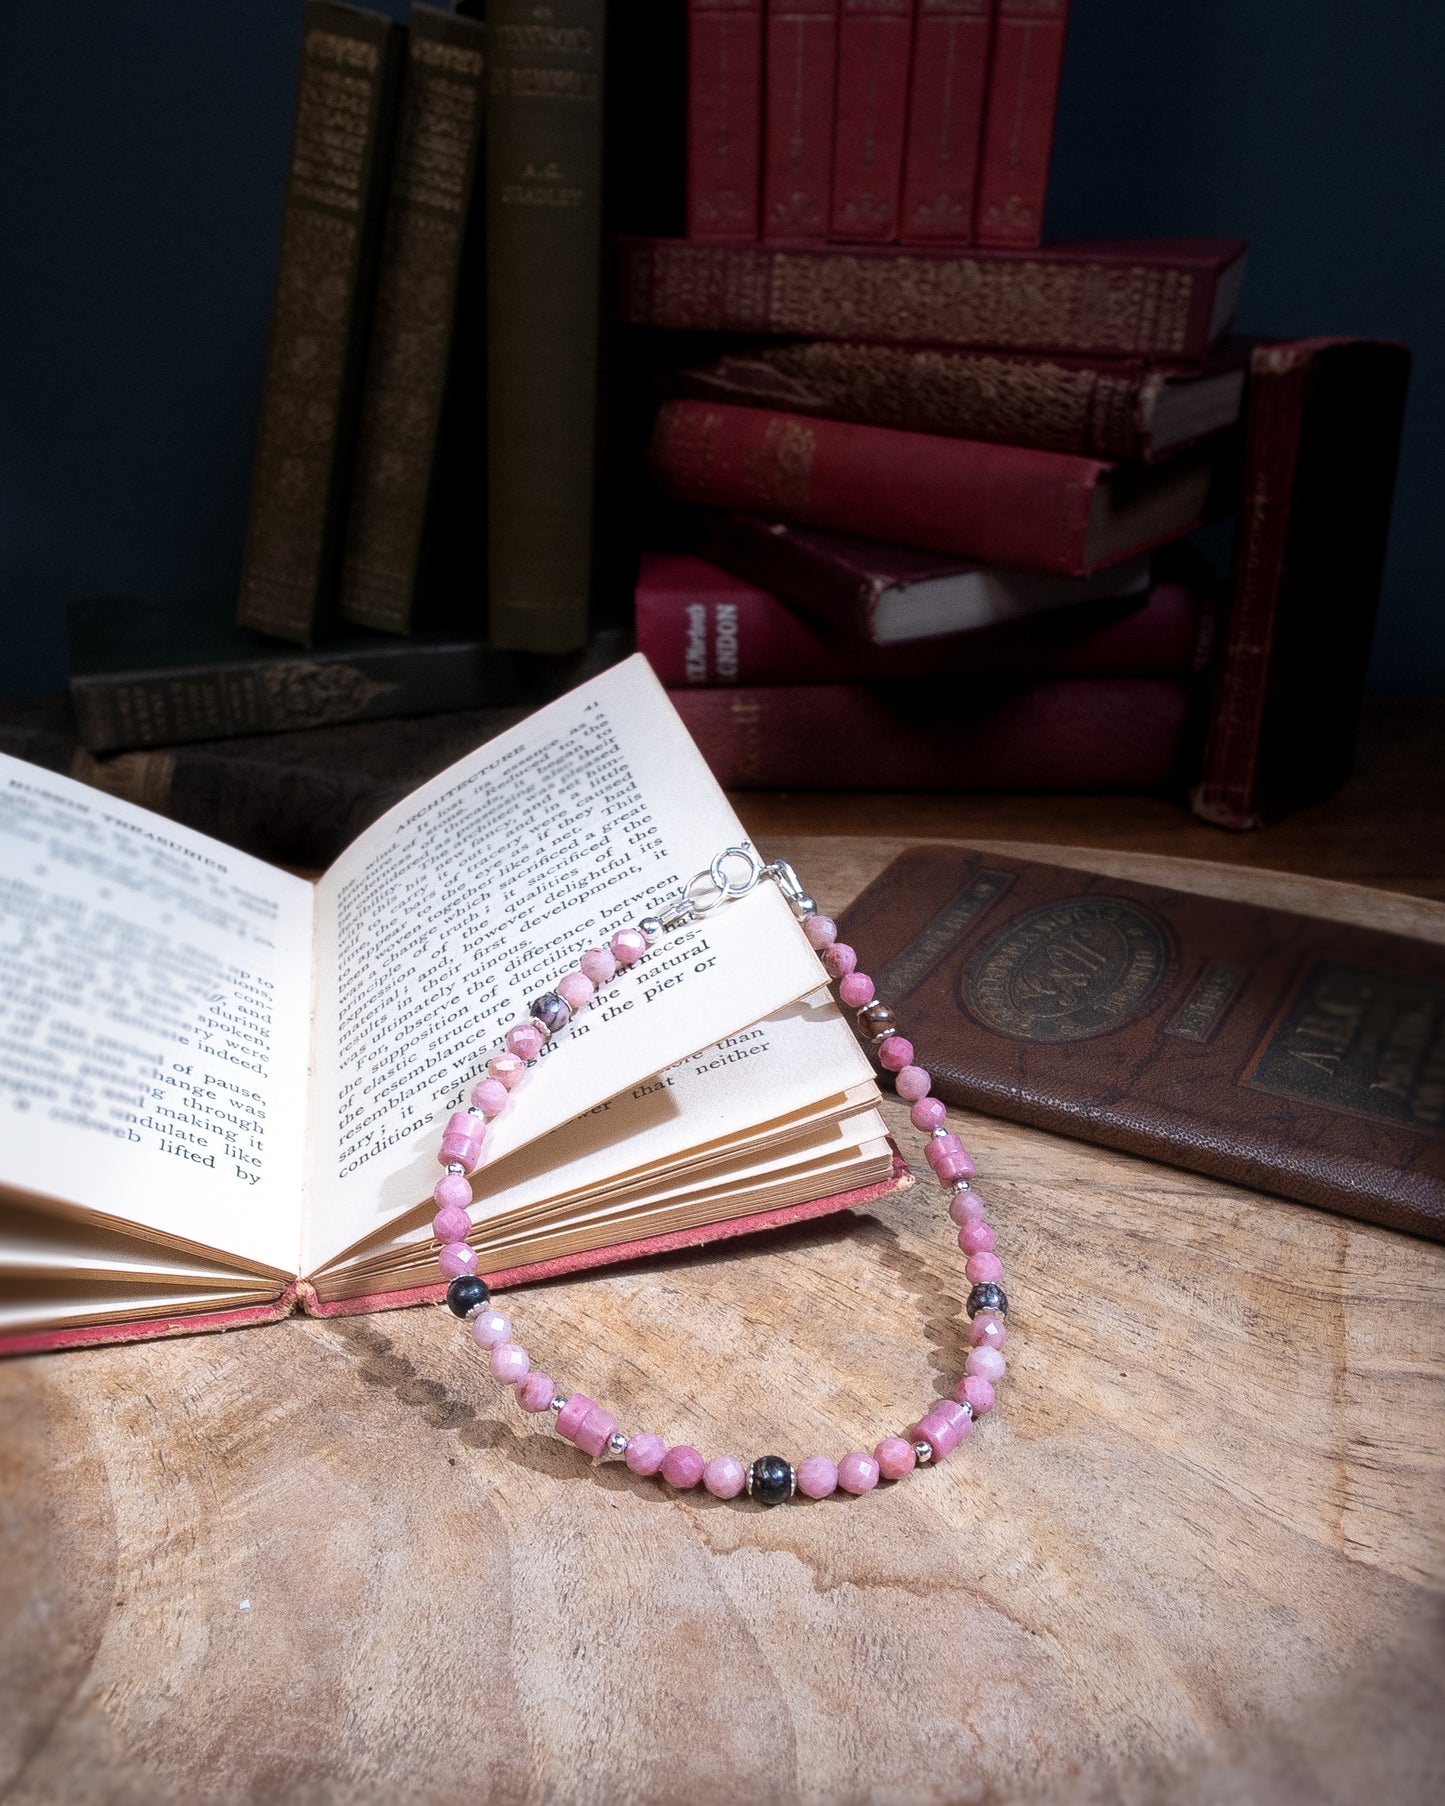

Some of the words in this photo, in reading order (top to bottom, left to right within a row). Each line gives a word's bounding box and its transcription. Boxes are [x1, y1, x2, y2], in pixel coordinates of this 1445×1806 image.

[355, 851, 430, 910] considered
[434, 837, 451, 850] as
[578, 735, 617, 761] their
[365, 843, 400, 870] wind.
[417, 821, 429, 833] It
[438, 798, 464, 818] lost
[473, 780, 491, 795] its
[502, 738, 559, 776] essence
[569, 723, 587, 735] as
[595, 712, 605, 721] a
[372, 895, 398, 917] this
[405, 874, 427, 892] his
[434, 849, 465, 872] new
[470, 818, 517, 848] fancy,
[521, 794, 552, 817] and
[557, 778, 581, 795] set
[585, 754, 625, 779] him-
[396, 744, 526, 834] ARCHITECTURE
[402, 837, 417, 852] of
[425, 807, 468, 836] stone.
[484, 752, 550, 796] Reduced
[559, 739, 575, 751] to
[583, 719, 609, 737] the
[418, 850, 449, 870] The
[453, 803, 520, 849] architect
[526, 782, 556, 802] was
[560, 743, 621, 784] pleased
[420, 834, 436, 850] of
[536, 744, 585, 776] began
[596, 728, 613, 740] to
[338, 933, 360, 960] self
[367, 919, 381, 932] to
[390, 884, 429, 914] carry
[438, 871, 450, 881] it
[505, 815, 536, 838] and
[544, 802, 561, 815] in
[570, 791, 580, 800] a
[590, 763, 630, 789] little
[338, 941, 370, 971] time,
[375, 918, 398, 937] the
[404, 890, 437, 915] bars
[443, 872, 460, 888] of
[467, 835, 522, 873] tracery
[529, 809, 568, 834] were
[576, 771, 634, 808] caused
[338, 969, 351, 983] to
[358, 921, 408, 964] appear
[416, 905, 432, 918] to
[441, 883, 466, 901] the
[474, 859, 503, 880] eye
[511, 843, 529, 857] as
[537, 828, 551, 842] if
[557, 806, 594, 829] they
[604, 782, 638, 804] had
[338, 963, 369, 992] been
[374, 924, 422, 960] woven
[427, 876, 496, 923] together
[499, 855, 530, 877] like
[535, 846, 546, 856] a
[551, 826, 583, 847] net.
[600, 793, 643, 817] This
[338, 977, 364, 1006] was
[368, 970, 377, 980] a
[382, 925, 439, 969] change
[443, 891, 491, 925] which
[499, 839, 580, 890] sacrificed
[585, 831, 596, 841] a
[601, 803, 648, 834] great
[338, 963, 402, 1022] principle
[413, 941, 430, 959] of
[503, 889, 517, 901] it
[528, 835, 612, 886] sacrificed
[622, 813, 653, 833] the
[417, 956, 455, 983] and,
[461, 905, 537, 954] however
[544, 852, 632, 905] delightful
[640, 838, 664, 854] its
[258, 977, 274, 990] to
[338, 966, 417, 1031] expression
[430, 941, 448, 959] of
[462, 919, 490, 939] the
[504, 868, 579, 914] qualities
[595, 846, 614, 864] of
[628, 825, 658, 846] the
[338, 1014, 388, 1059] results
[396, 996, 413, 1011] in
[422, 962, 464, 994] their
[472, 935, 508, 962] first
[519, 865, 643, 933] development,
[653, 849, 670, 860] it
[356, 1045, 390, 1072] For,
[394, 995, 461, 1042] observe
[466, 975, 496, 995] the
[504, 917, 596, 973] difference
[599, 873, 680, 919] between
[198, 1014, 270, 1051] spoken,
[209, 1005, 270, 1038] during
[225, 1039, 270, 1063] were
[233, 990, 273, 1011] con-
[238, 1005, 272, 1024] and
[338, 1076, 363, 1100] the
[371, 1006, 470, 1074] supposition
[479, 984, 499, 1003] of
[508, 938, 593, 987] ductility,
[598, 911, 636, 936] and
[645, 885, 685, 910] that
[338, 1044, 367, 1070] was
[371, 981, 456, 1044] ultimately
[461, 939, 533, 984] ruinous.
[338, 1068, 449, 1147] resemblance
[452, 1044, 488, 1069] was
[639, 929, 703, 965] neces-
[400, 1105, 415, 1119] it
[588, 988, 620, 1011] the
[636, 939, 711, 985] natural
[716, 1028, 765, 1051] than
[138, 1066, 217, 1100] change
[229, 1098, 266, 1119] was
[172, 1063, 195, 1075] of
[203, 1073, 266, 1107] pause,
[182, 1096, 265, 1135] through
[197, 1039, 268, 1078] indeed,
[338, 1094, 354, 1115] of
[362, 1053, 418, 1095] elastic
[428, 998, 511, 1051] structure
[338, 1112, 434, 1179] conditions
[445, 1090, 465, 1110] of
[570, 1024, 590, 1040] in
[600, 999, 634, 1023] the
[643, 972, 685, 1003] pier
[694, 956, 718, 973] or
[338, 1105, 365, 1130] the
[374, 1028, 487, 1103] resemblance
[496, 1012, 516, 1026] to
[631, 1076, 675, 1100] that
[695, 1041, 771, 1075] neither
[109, 1106, 208, 1148] undulate
[223, 1144, 263, 1168] like
[155, 1105, 239, 1143] making
[249, 1136, 264, 1151] it
[159, 1139, 216, 1169] lifted
[236, 1165, 261, 1185] by
